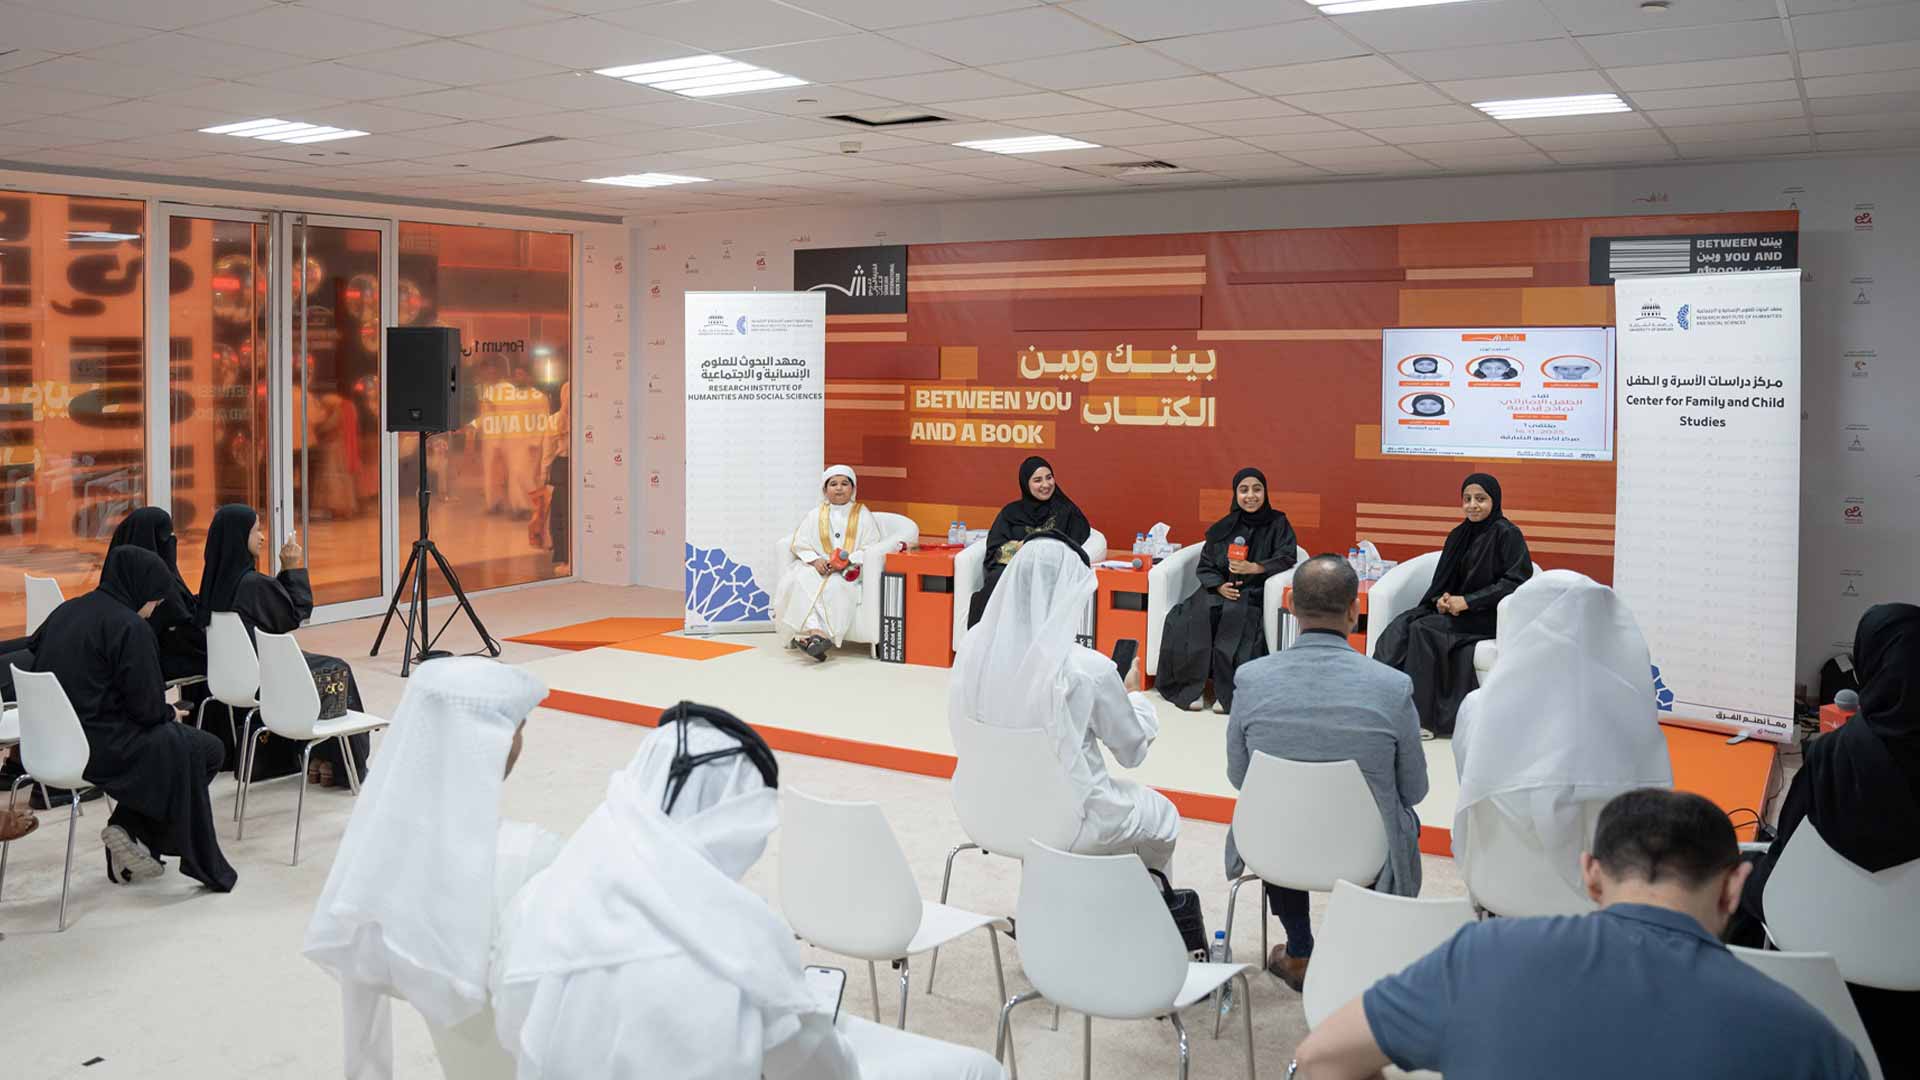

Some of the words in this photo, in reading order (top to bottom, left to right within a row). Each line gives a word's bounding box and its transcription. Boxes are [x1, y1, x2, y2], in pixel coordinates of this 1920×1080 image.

[1696, 238, 1758, 249] BETWEEN
[1760, 237, 1783, 249] بينك
[1696, 251, 1721, 263] وبين
[1724, 252, 1750, 262] YOU
[1754, 251, 1783, 262] AND
[701, 356, 738, 368] للعلوم
[740, 355, 773, 368] البحوث
[774, 357, 806, 367] معهد
[1020, 344, 1098, 382] وبين
[1106, 344, 1216, 382] بينك
[701, 368, 755, 381] الاجتماعية
[756, 372, 762, 381] و
[764, 368, 810, 381] الإنسانية
[1626, 375, 1660, 387] الطفل
[1670, 373, 1706, 388] الأسرة
[708, 384, 750, 392] RESEARCH
[1661, 378, 1668, 388] و
[1708, 375, 1751, 389] دراسات
[1752, 376, 1783, 389] مركز
[688, 393, 737, 401] HUMANITIES
[738, 393, 755, 401] AND
[915, 389, 1021, 410] BETWEEN
[1026, 391, 1072, 411] YOU
[1626, 395, 1663, 406] Center
[1665, 395, 1683, 406] for
[1685, 396, 1726, 409] Family
[1727, 397, 1749, 407] and
[1751, 397, 1785, 408] Child
[1082, 395, 1216, 433] الكتاب
[1679, 416, 1726, 427] Studies
[911, 422, 956, 441] AND
[960, 423, 977, 442] A
[981, 424, 1044, 444] BOOK
